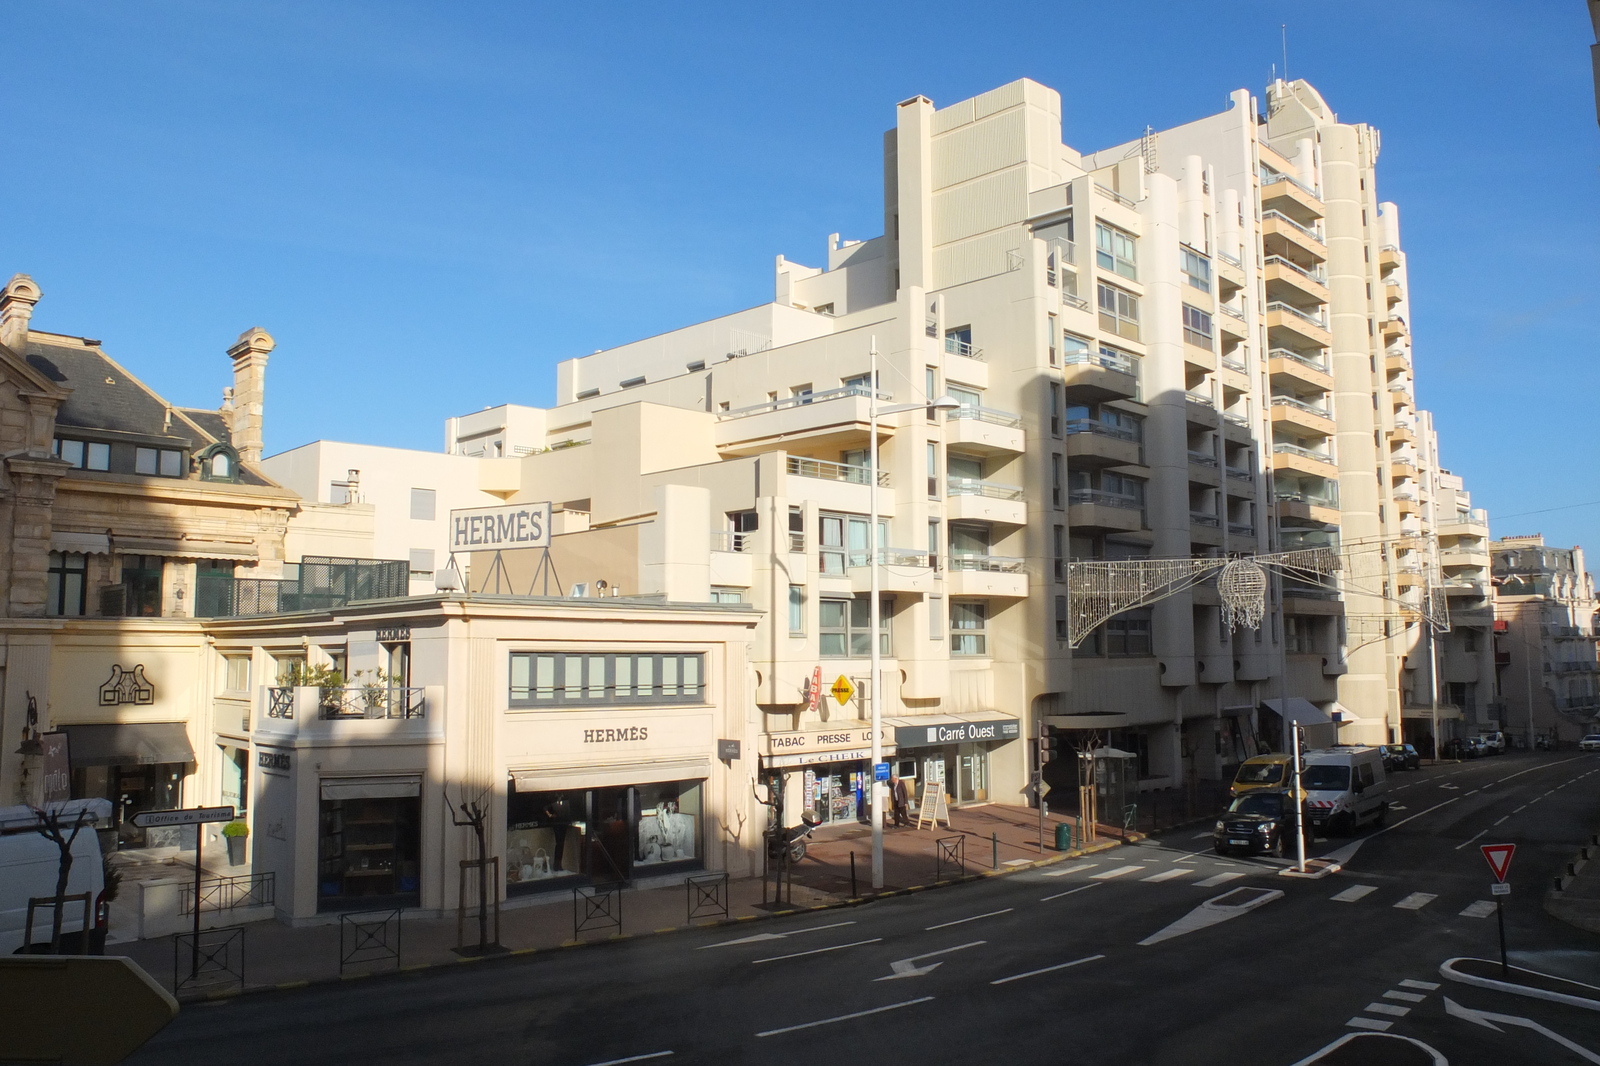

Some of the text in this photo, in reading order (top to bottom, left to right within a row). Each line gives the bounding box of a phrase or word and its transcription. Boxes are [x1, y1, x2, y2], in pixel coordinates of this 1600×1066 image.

[455, 510, 542, 545] HERMÈS
[810, 667, 818, 710] TABAC
[584, 726, 648, 743] HERMÈS
[771, 736, 805, 747] TABAC
[817, 733, 851, 744] PRESSE
[939, 725, 965, 741] Carré
[968, 724, 995, 739] Ouest
[818, 751, 864, 762] CHEIK
[199, 811, 231, 819] Tourisme
